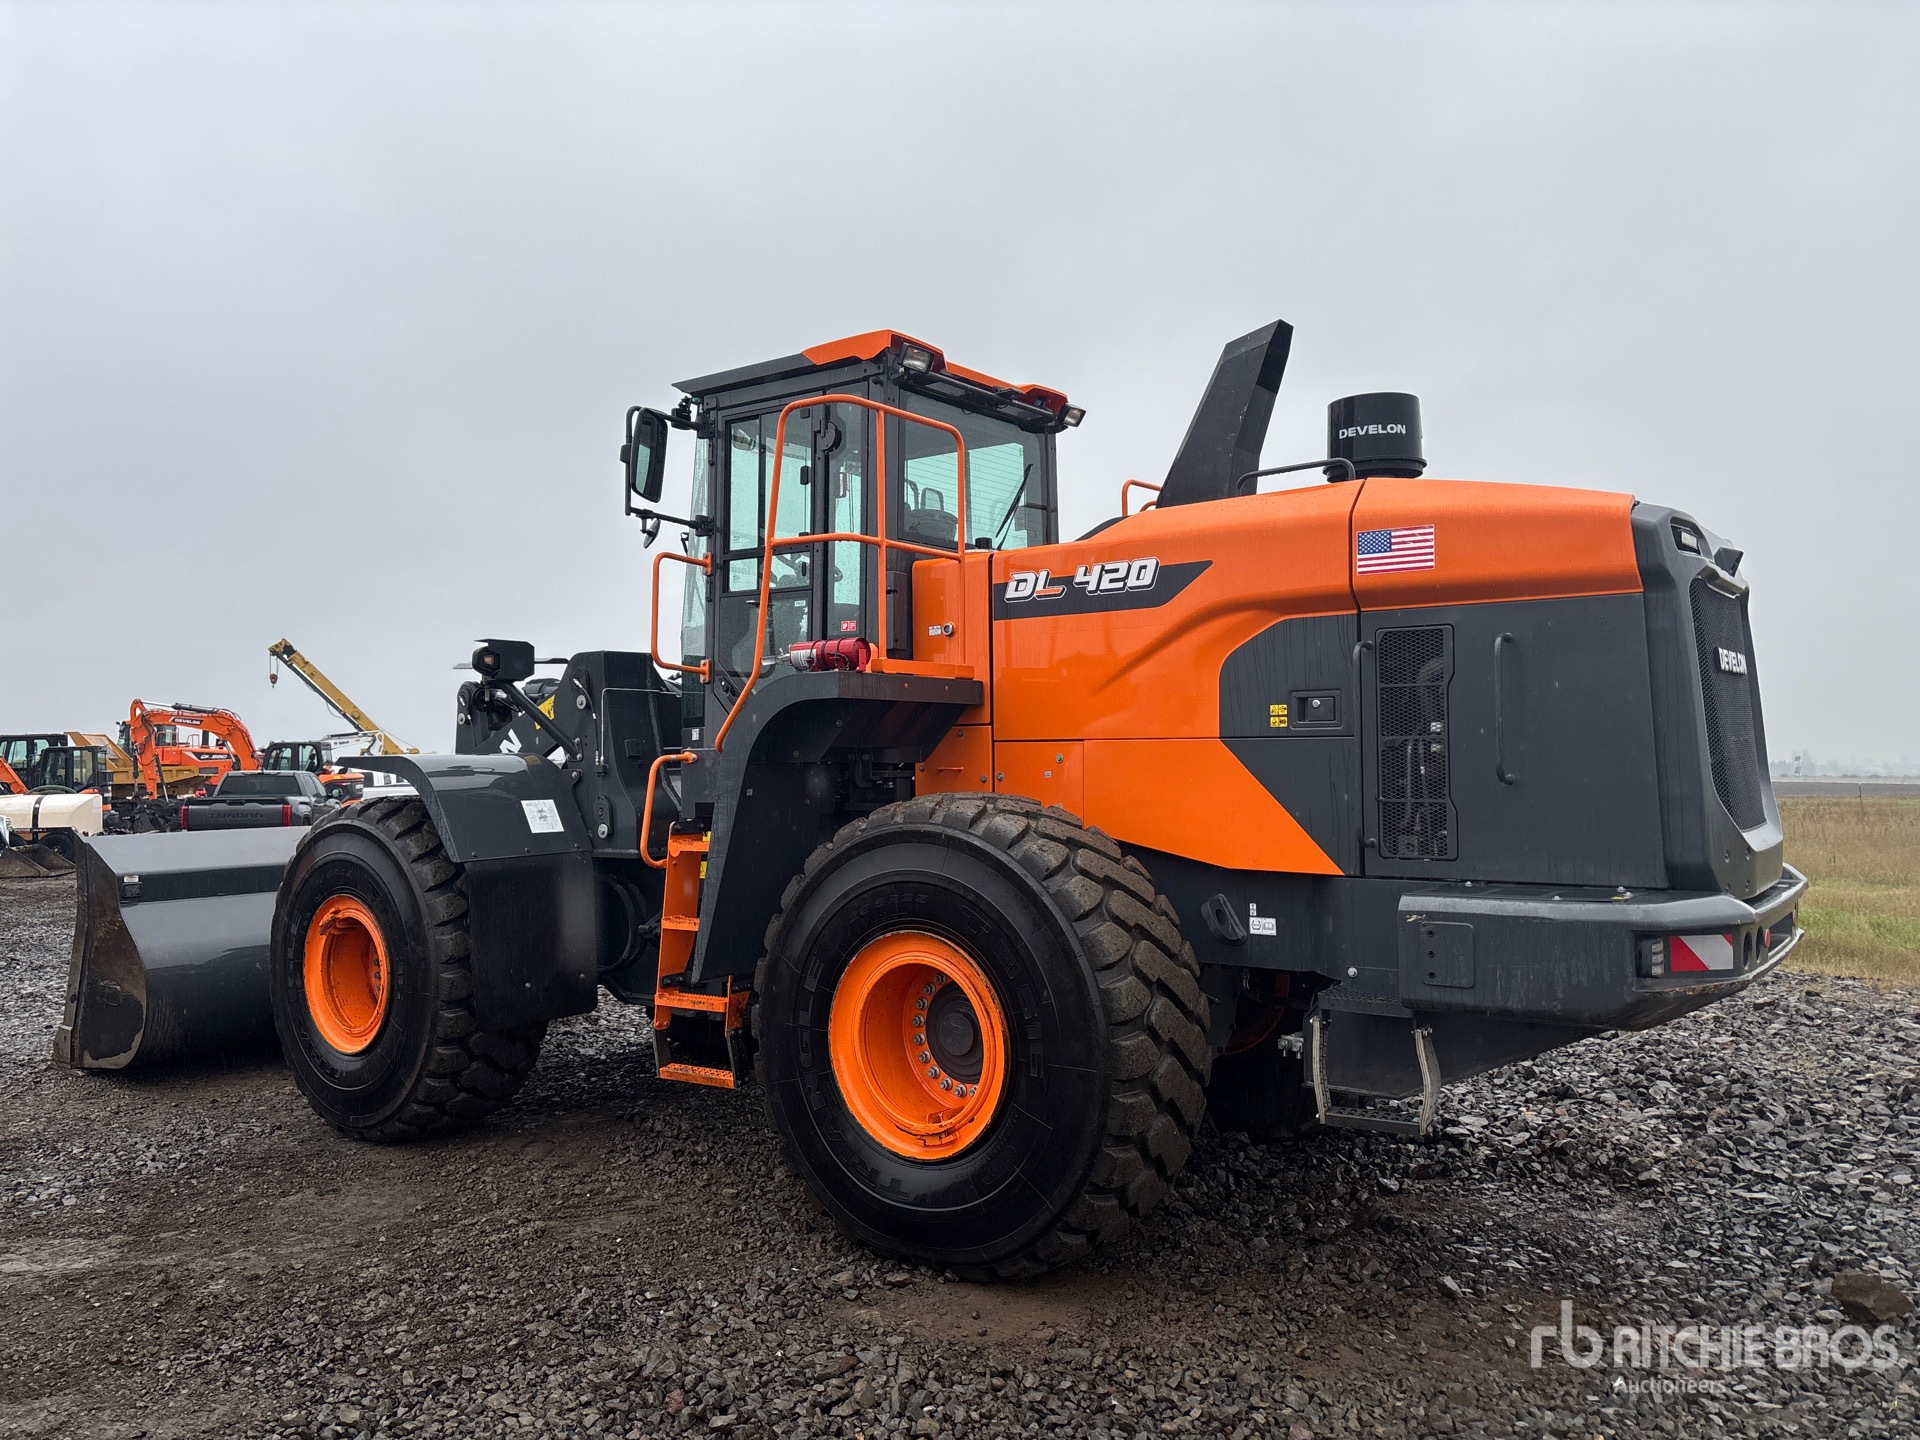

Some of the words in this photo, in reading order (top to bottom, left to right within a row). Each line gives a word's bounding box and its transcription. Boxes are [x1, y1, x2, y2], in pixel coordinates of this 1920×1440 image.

[1338, 423, 1407, 440] DEVELON
[1004, 569, 1067, 603] DL
[1073, 557, 1160, 595] 420
[1718, 647, 1748, 675] DEVELON
[209, 812, 263, 820] TUNDRA
